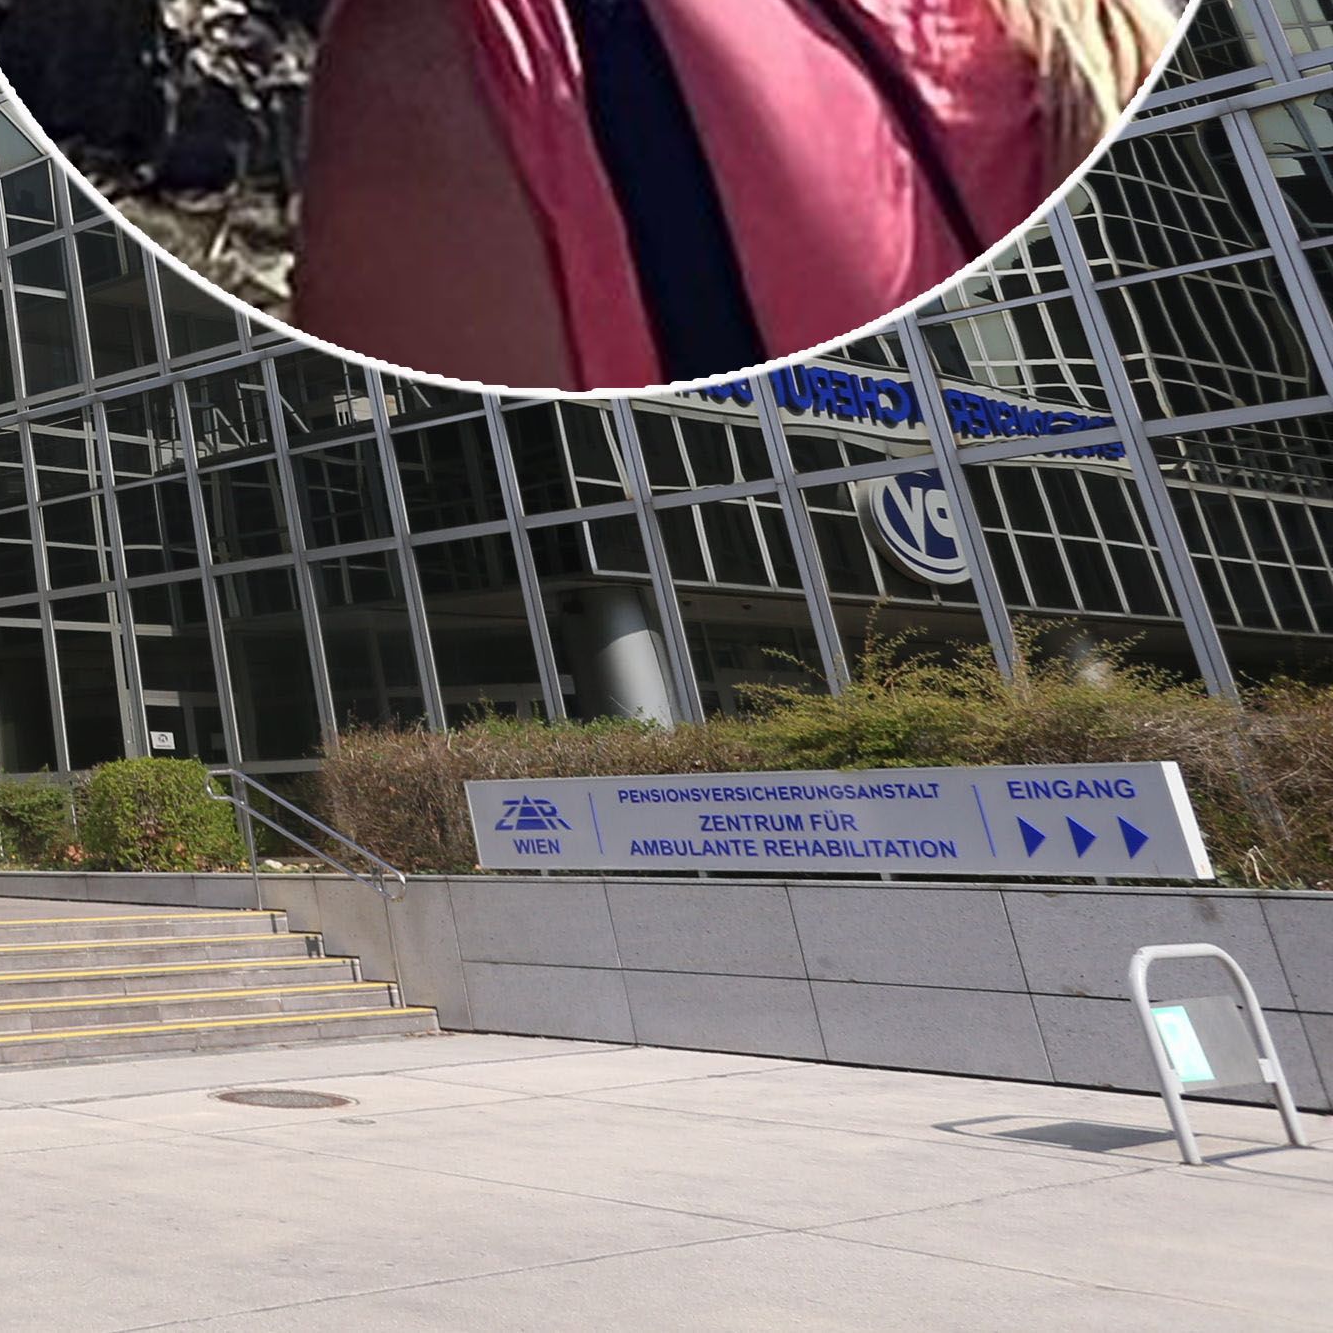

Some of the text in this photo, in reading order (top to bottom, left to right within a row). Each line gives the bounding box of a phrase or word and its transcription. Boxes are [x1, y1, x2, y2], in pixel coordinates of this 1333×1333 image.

[618, 782, 940, 804] PENSIONSVERSICHERUNGSANSTALT
[1006, 778, 1136, 800] EINGANG
[698, 810, 859, 832] ZENTRUM FÜR
[513, 838, 561, 855] WIEN
[630, 839, 958, 859] AMBULANTE REHABILITATION
